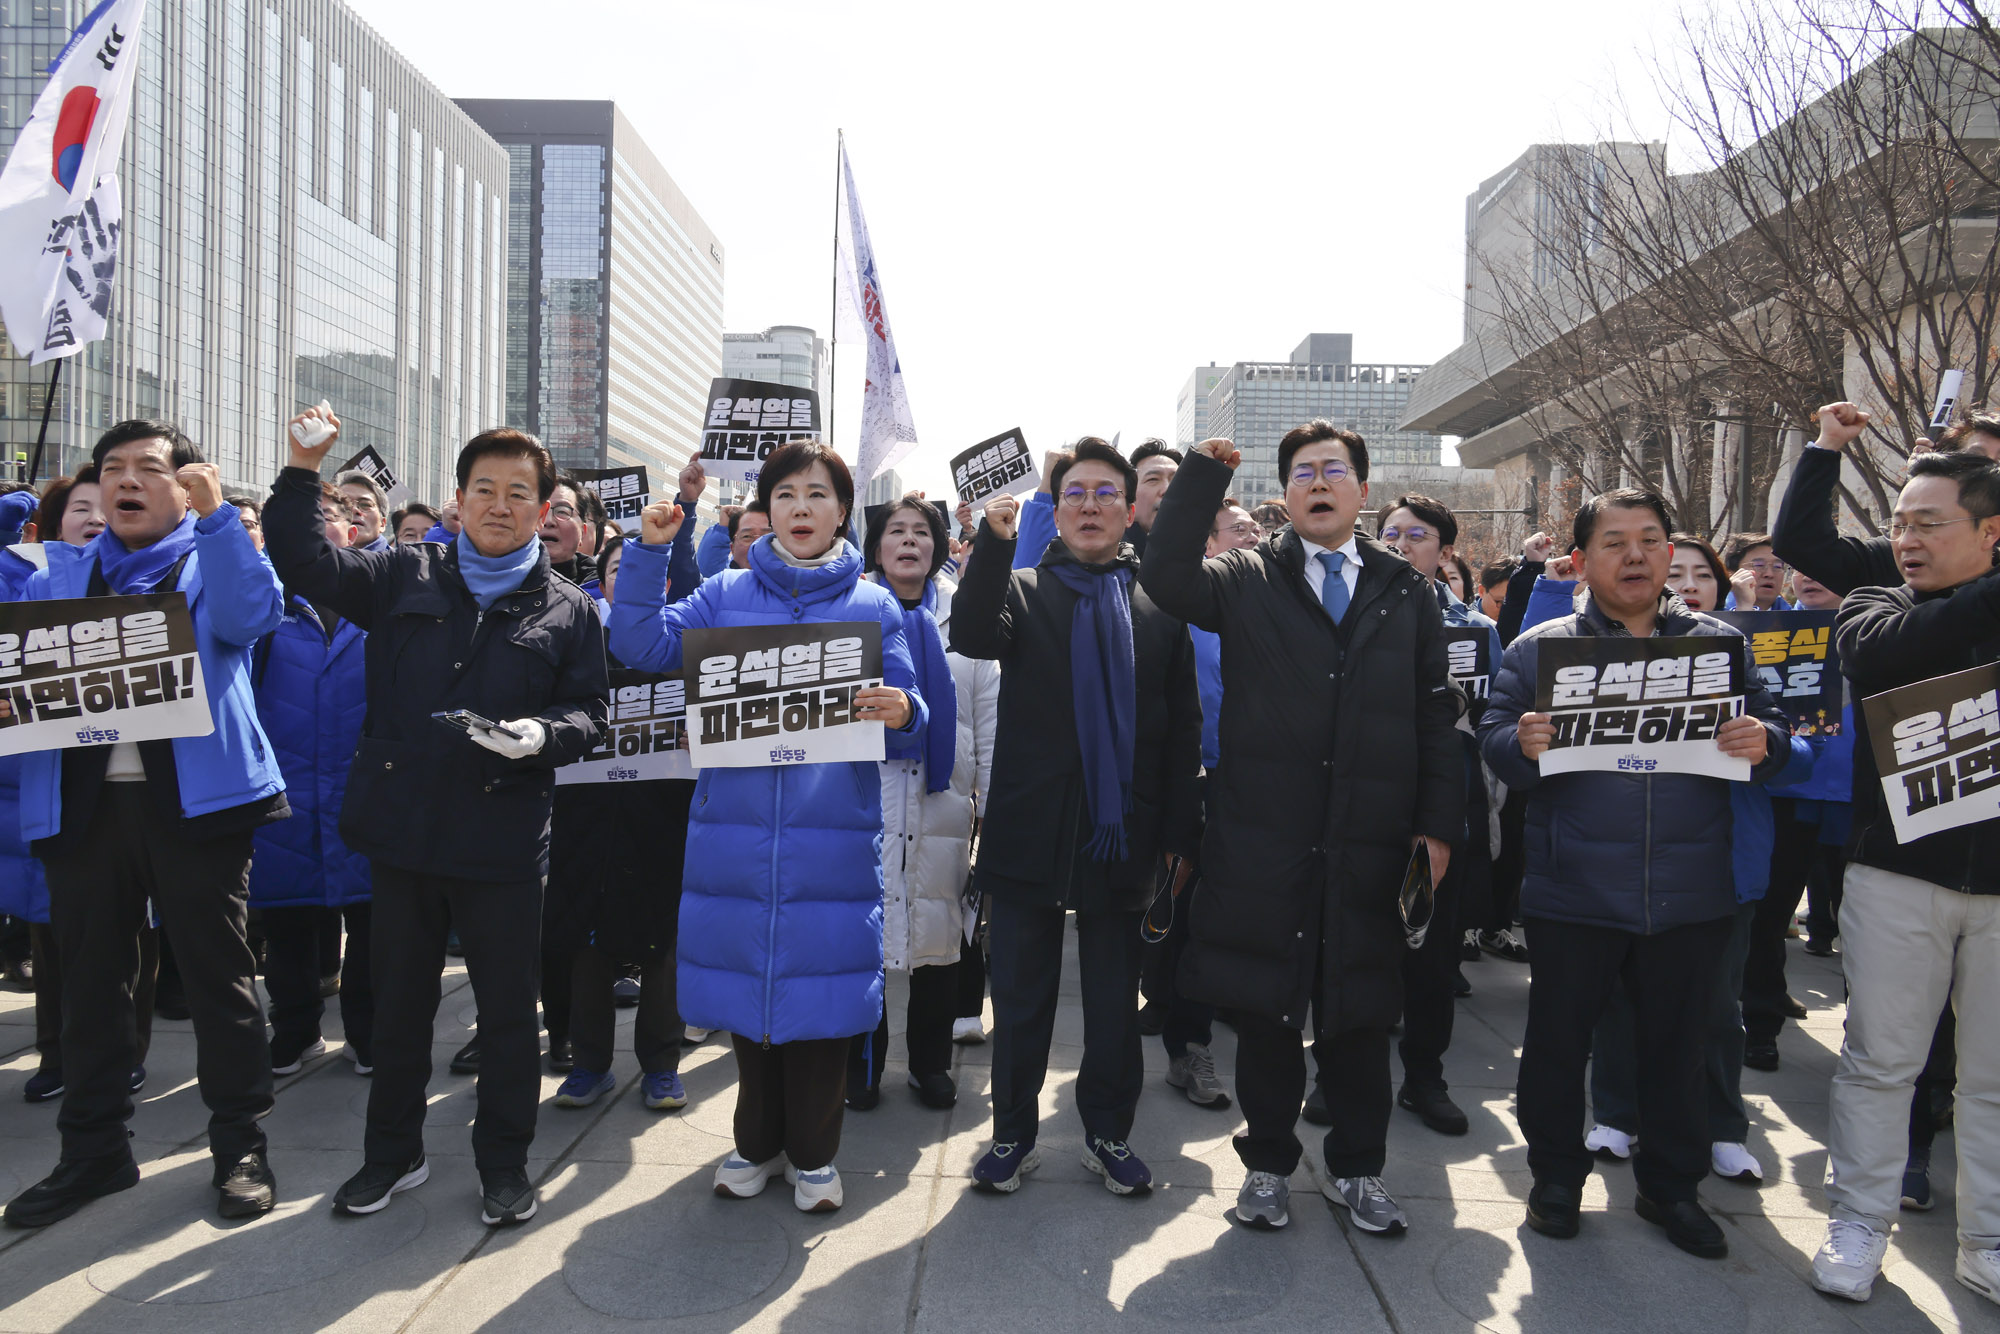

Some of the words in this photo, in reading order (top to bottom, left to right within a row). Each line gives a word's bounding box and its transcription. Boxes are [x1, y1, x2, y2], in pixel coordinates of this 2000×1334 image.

[707, 397, 812, 428] 윤석열을
[956, 437, 1020, 488] 윤석열을
[960, 453, 1033, 505] 파면하라!
[1751, 626, 1830, 665] 종식
[699, 636, 863, 698] 윤석열을
[1552, 652, 1731, 707] 윤석열을
[609, 679, 686, 721] 열을
[700, 681, 880, 746] 파면하라
[76, 729, 120, 744] 민주당
[769, 749, 807, 763] 민주당
[607, 769, 639, 781] 민주당
[1617, 758, 1658, 771] 민주당
